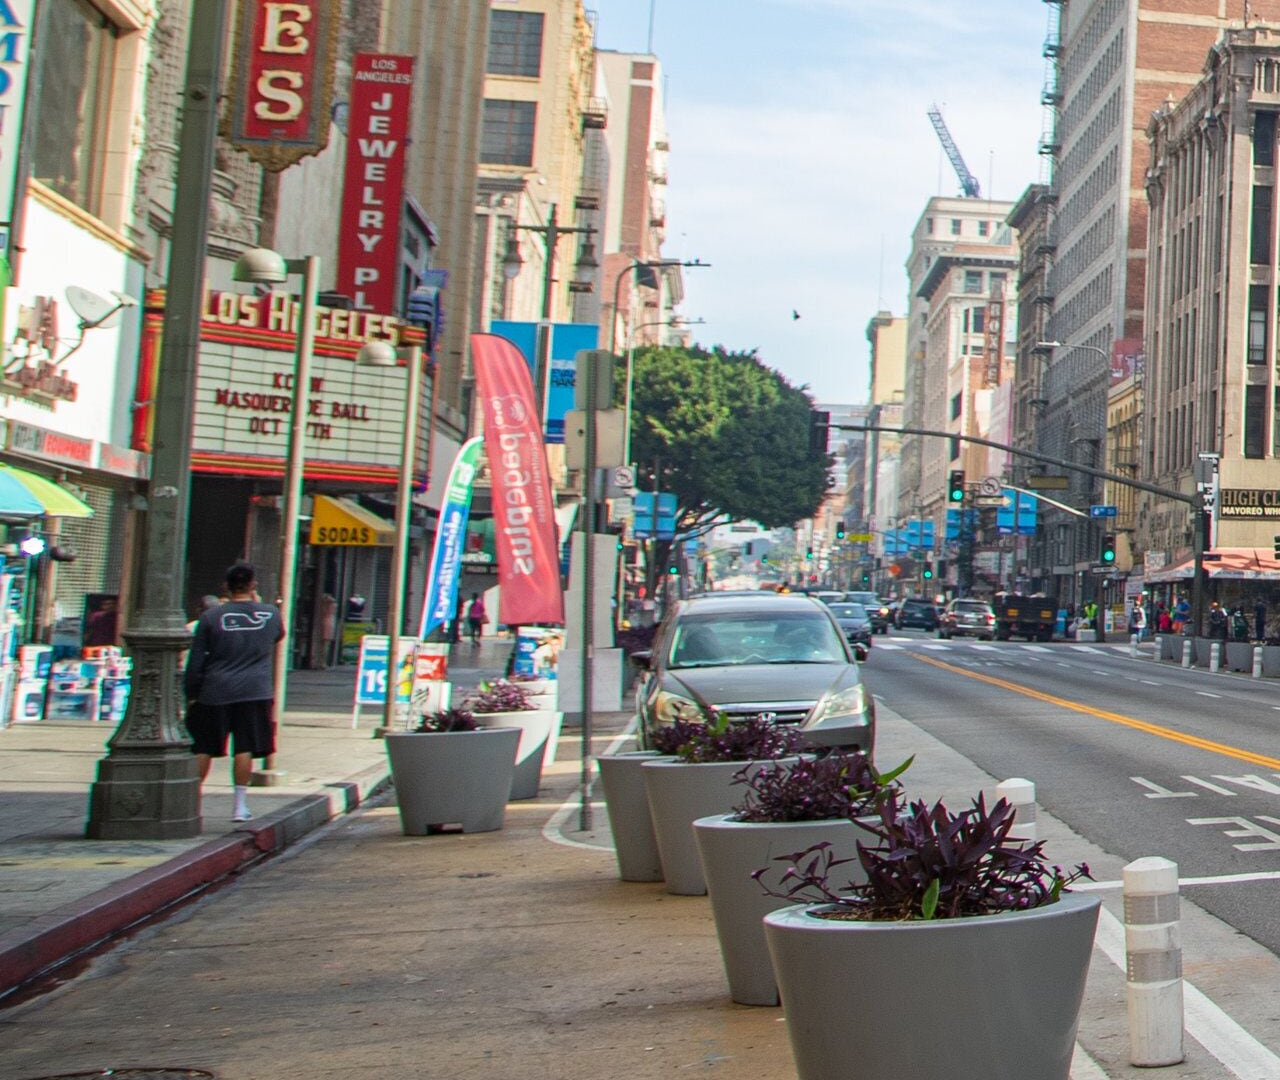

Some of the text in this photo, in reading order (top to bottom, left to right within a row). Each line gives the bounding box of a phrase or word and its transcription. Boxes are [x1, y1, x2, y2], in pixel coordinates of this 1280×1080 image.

[371, 59, 397, 70] LOS
[355, 71, 410, 84] ANGELES
[358, 92, 397, 253] JEWELRY
[201, 279, 259, 328] LOS
[271, 371, 324, 394] KCW
[214, 388, 370, 422] MASQUERDE BALL
[248, 416, 281, 436] OCT
[1221, 491, 1260, 507] HIGH
[1222, 506, 1263, 516] MAYOREO
[318, 526, 370, 544] SODAS
